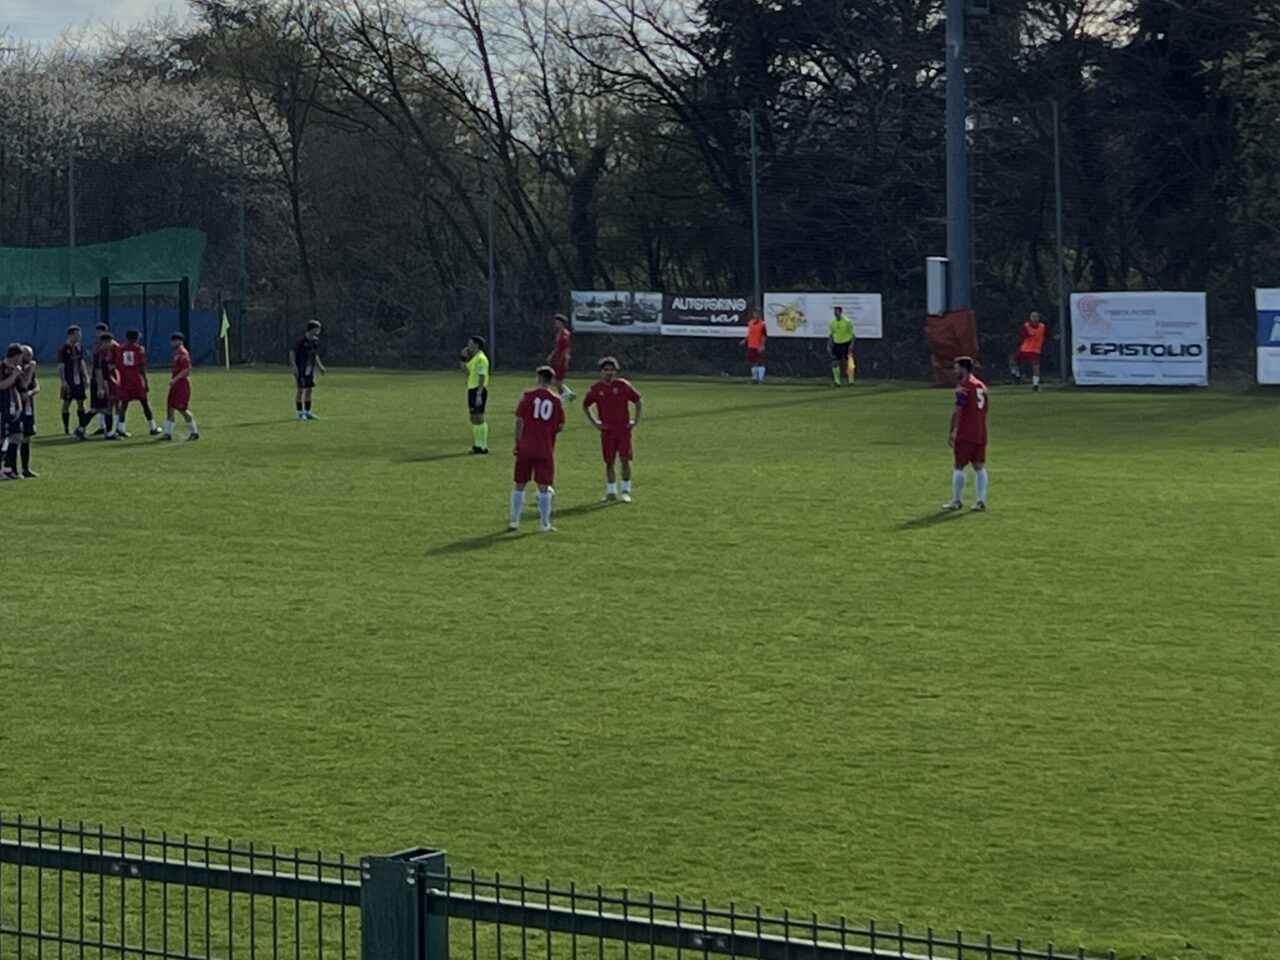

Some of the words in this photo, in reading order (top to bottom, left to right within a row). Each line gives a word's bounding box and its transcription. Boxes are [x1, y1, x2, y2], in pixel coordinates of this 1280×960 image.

[1090, 342, 1202, 356] EPISTOLIO
[534, 397, 553, 420] 10
[976, 388, 986, 409] 5
